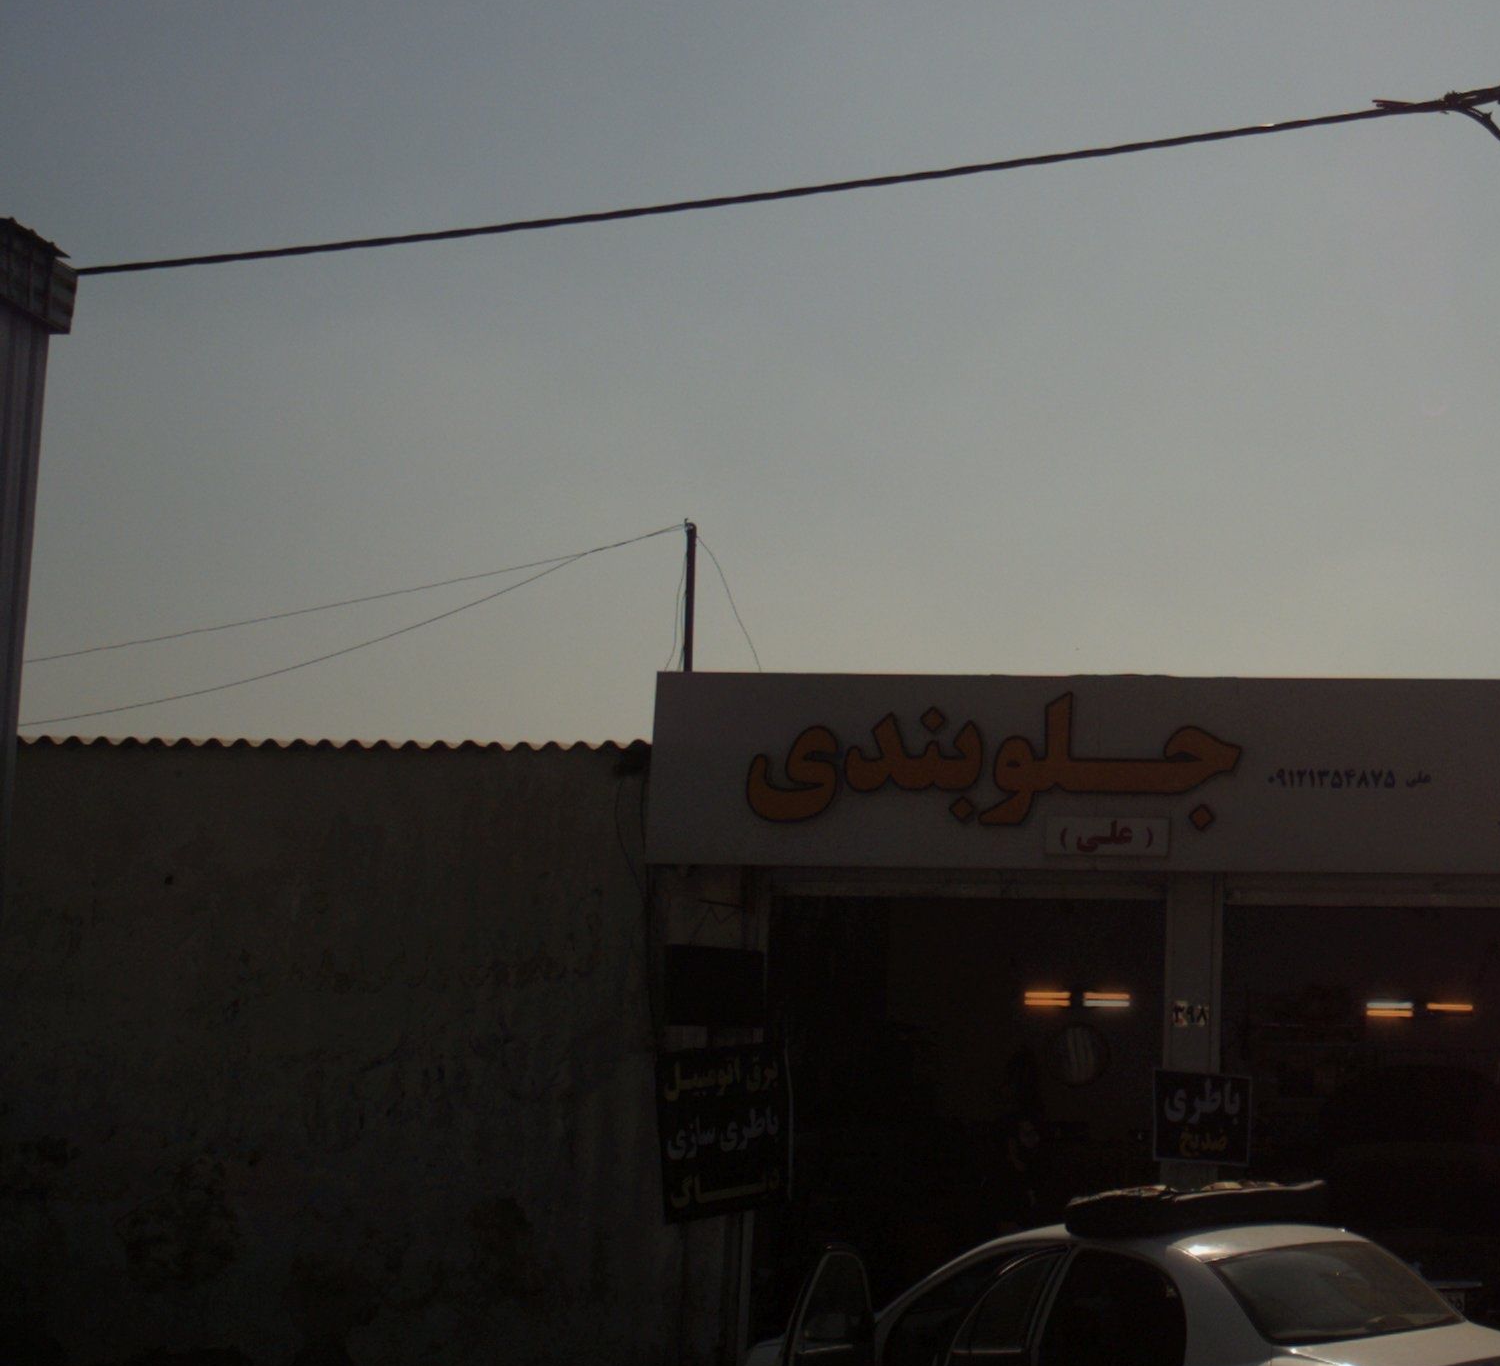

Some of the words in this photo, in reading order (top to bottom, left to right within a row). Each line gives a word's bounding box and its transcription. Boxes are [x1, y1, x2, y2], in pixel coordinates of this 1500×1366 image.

[746, 691, 1242, 833] جلوبندی
[1164, 1078, 1240, 1125] باطری
[667, 1115, 716, 1161] سازی
[719, 1105, 780, 1152] باطری
